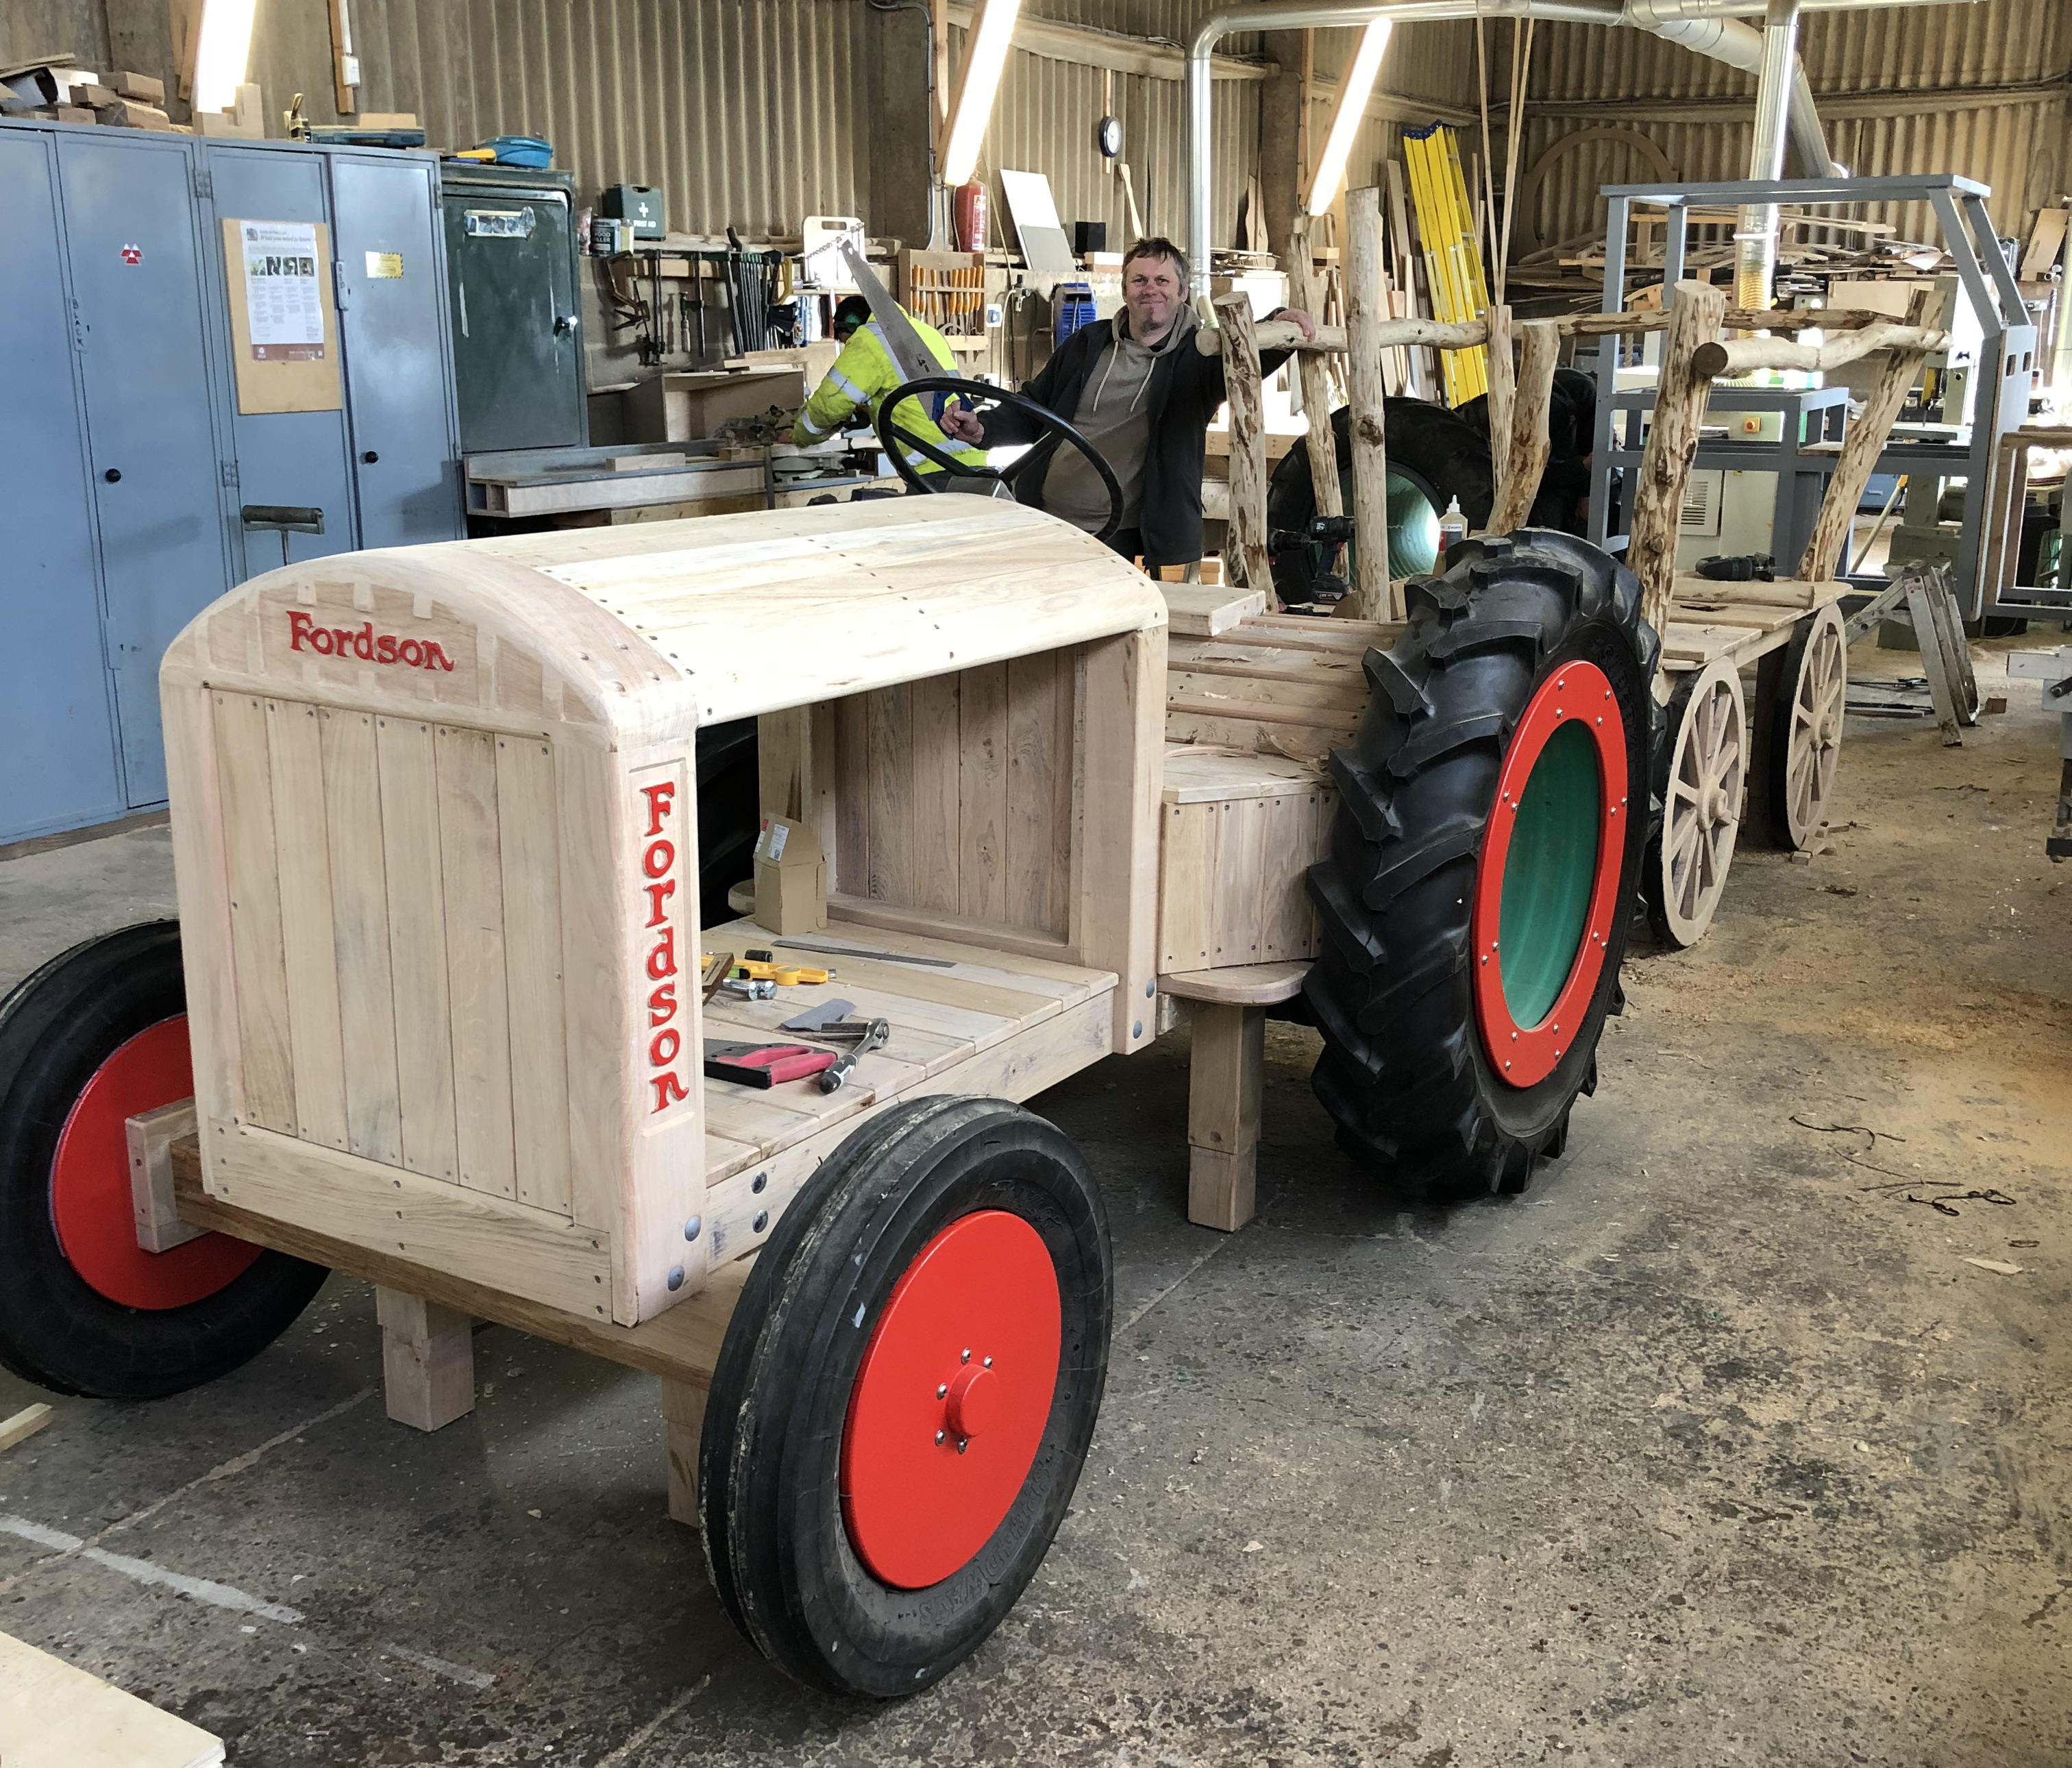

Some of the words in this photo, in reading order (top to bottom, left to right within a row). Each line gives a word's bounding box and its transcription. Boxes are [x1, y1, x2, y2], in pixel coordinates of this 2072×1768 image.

[73, 298, 84, 347] BLACK
[286, 610, 454, 672] Fordson
[639, 781, 689, 1114] Fordson
